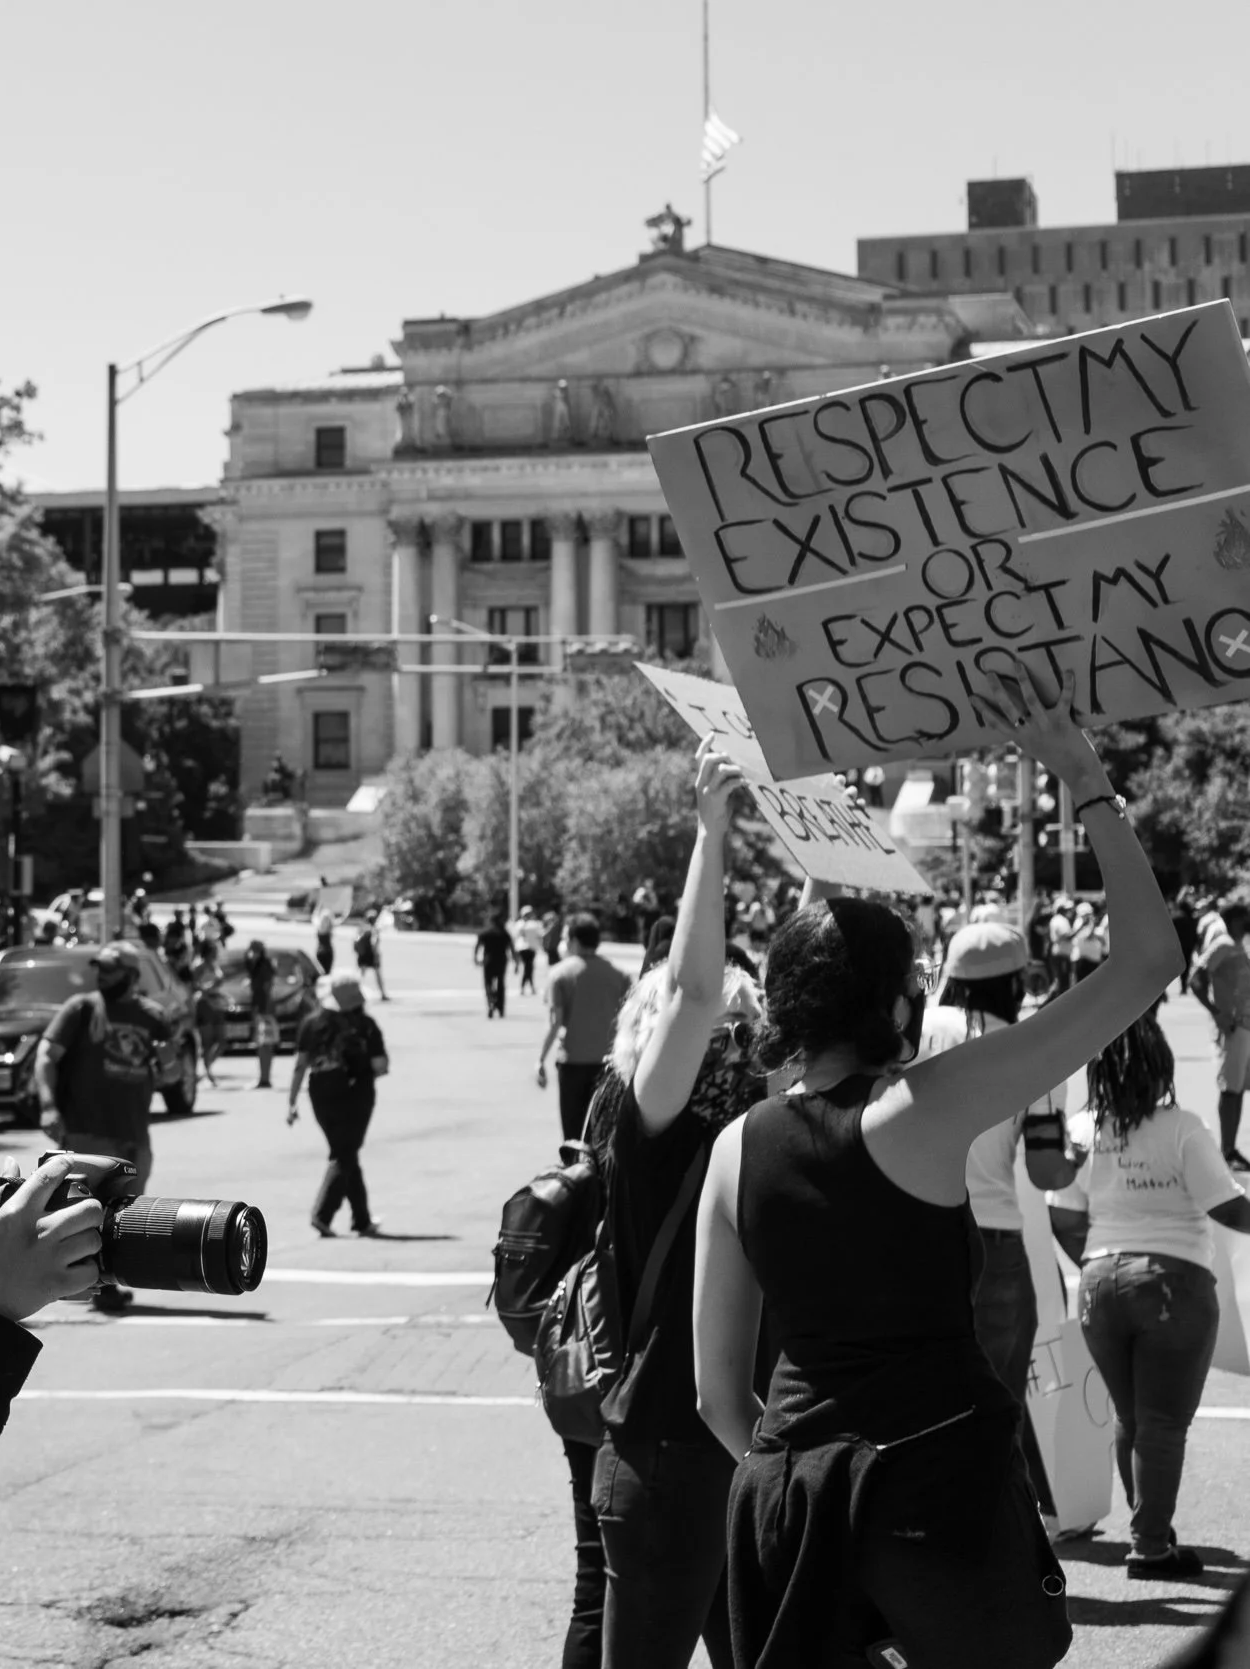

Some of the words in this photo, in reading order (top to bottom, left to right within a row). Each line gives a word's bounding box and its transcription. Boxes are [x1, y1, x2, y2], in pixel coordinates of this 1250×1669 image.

[693, 351, 1070, 523] RESPECT
[1079, 319, 1200, 435] MY
[714, 424, 1204, 595] EXISTENCE
[921, 538, 1027, 600] OR
[822, 579, 1071, 667] EXPECT
[1093, 553, 1172, 623] MY
